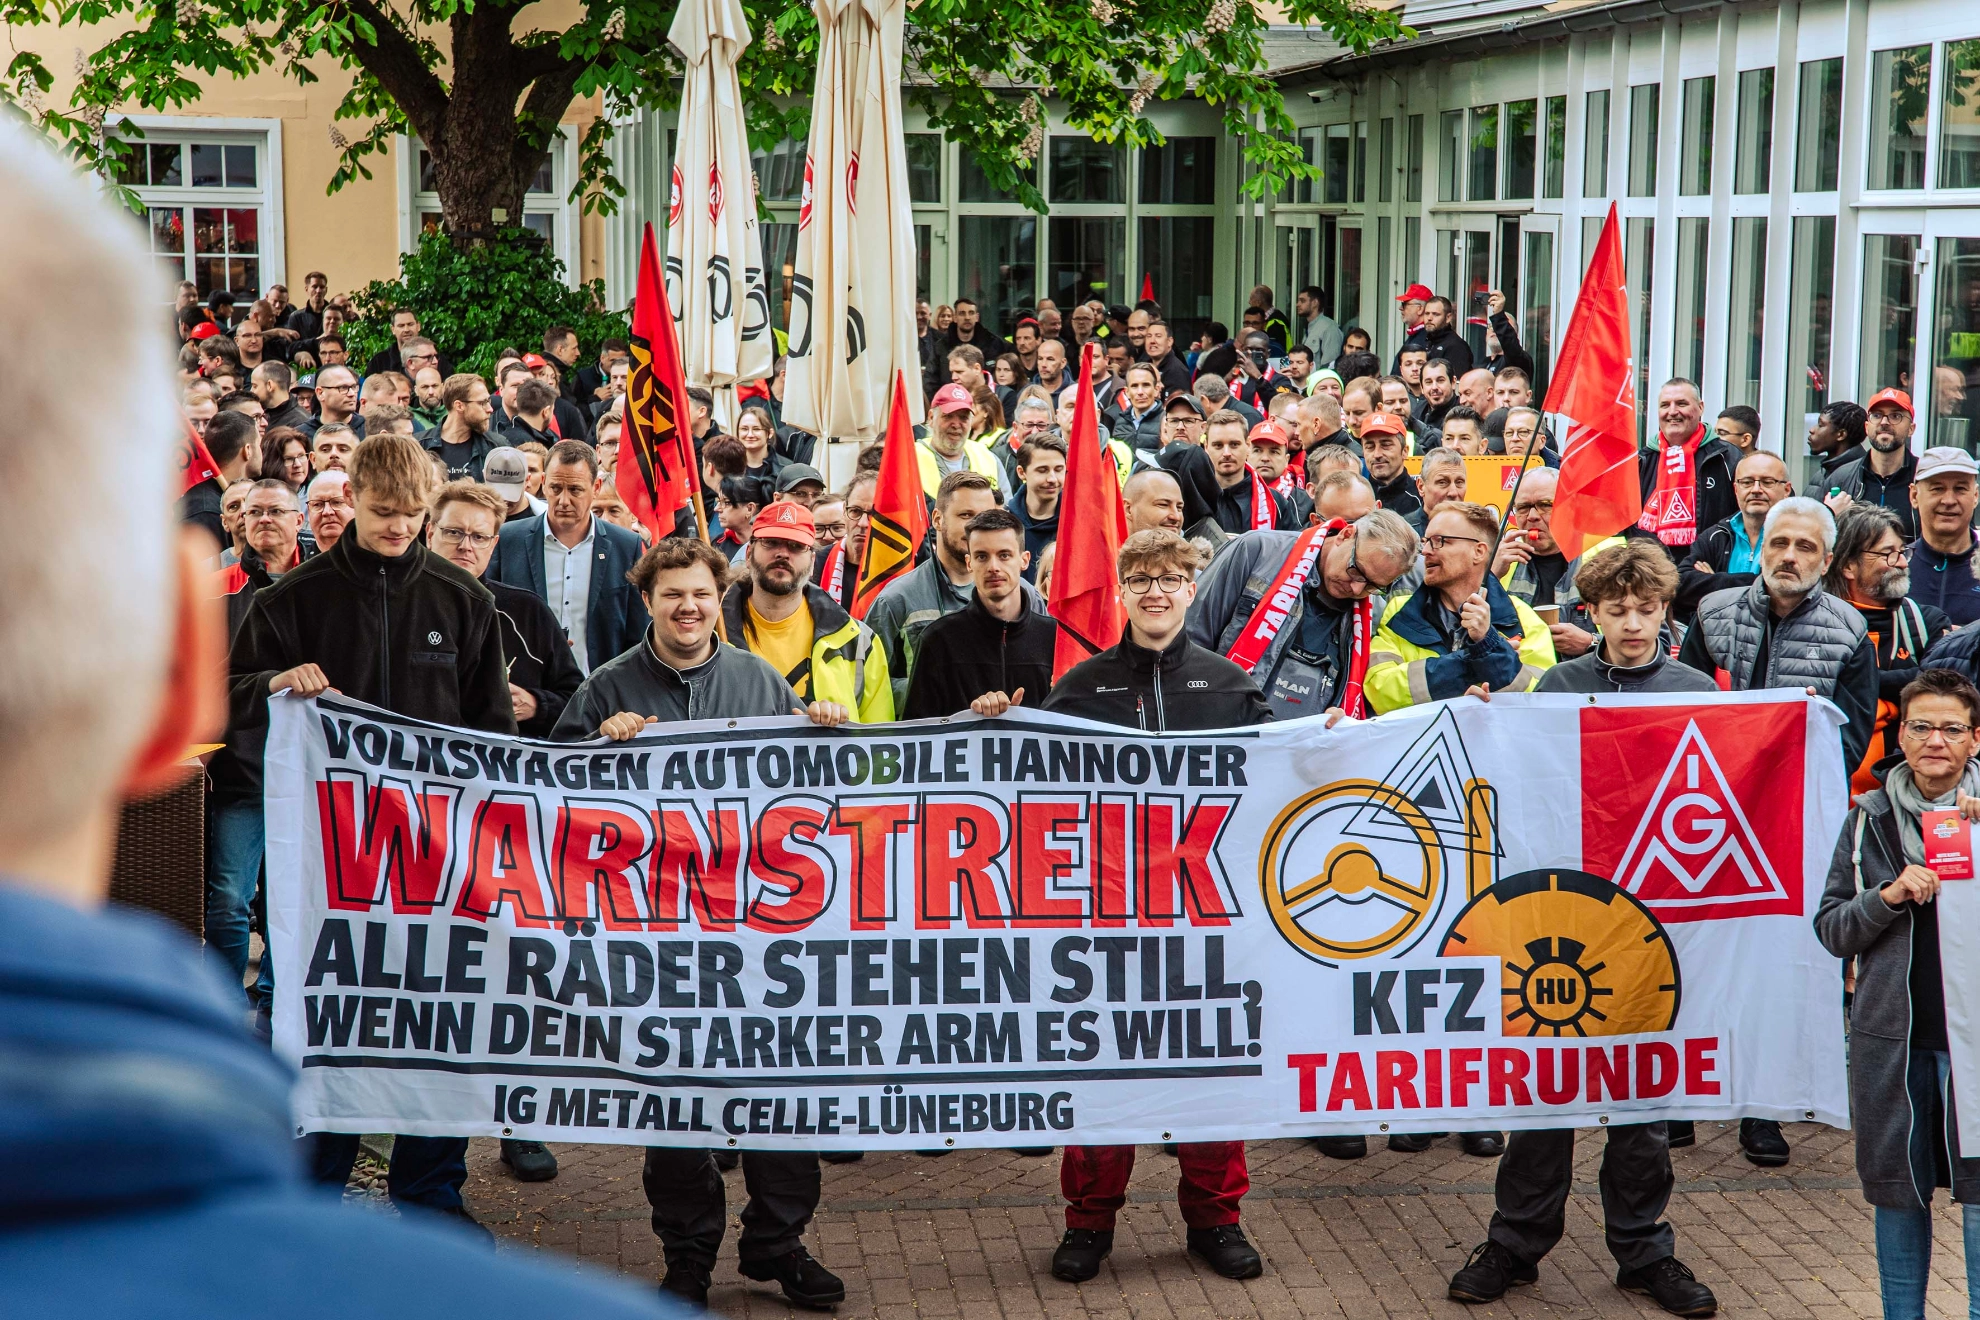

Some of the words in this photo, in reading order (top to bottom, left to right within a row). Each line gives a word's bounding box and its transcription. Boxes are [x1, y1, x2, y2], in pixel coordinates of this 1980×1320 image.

[1275, 677, 1310, 695] MAN
[319, 713, 651, 792] VOLKSWAGEN
[660, 739, 969, 791] AUTOMOBILE
[981, 737, 1249, 787] HANNOVER
[315, 768, 1244, 933] WARNSTREIK
[304, 918, 490, 994] ALLE
[506, 920, 746, 1009] RÄDER
[762, 936, 1031, 1008] STEHEN
[1050, 934, 1263, 1005] STILL,
[1352, 966, 1486, 1037] KFZ
[1535, 977, 1577, 1005] HU
[304, 994, 476, 1055] WENN
[487, 1002, 624, 1065] DEIN
[634, 1013, 884, 1070] STARKER
[896, 1011, 1022, 1066] ARM
[1036, 1010, 1101, 1063] ES
[1112, 1002, 1262, 1059] WILL!
[494, 1084, 537, 1125] IG
[545, 1088, 716, 1133] METALL
[722, 1084, 1075, 1136] CELLE-LÜNEBURG
[1287, 1036, 1721, 1113] TARIFRUNDE
